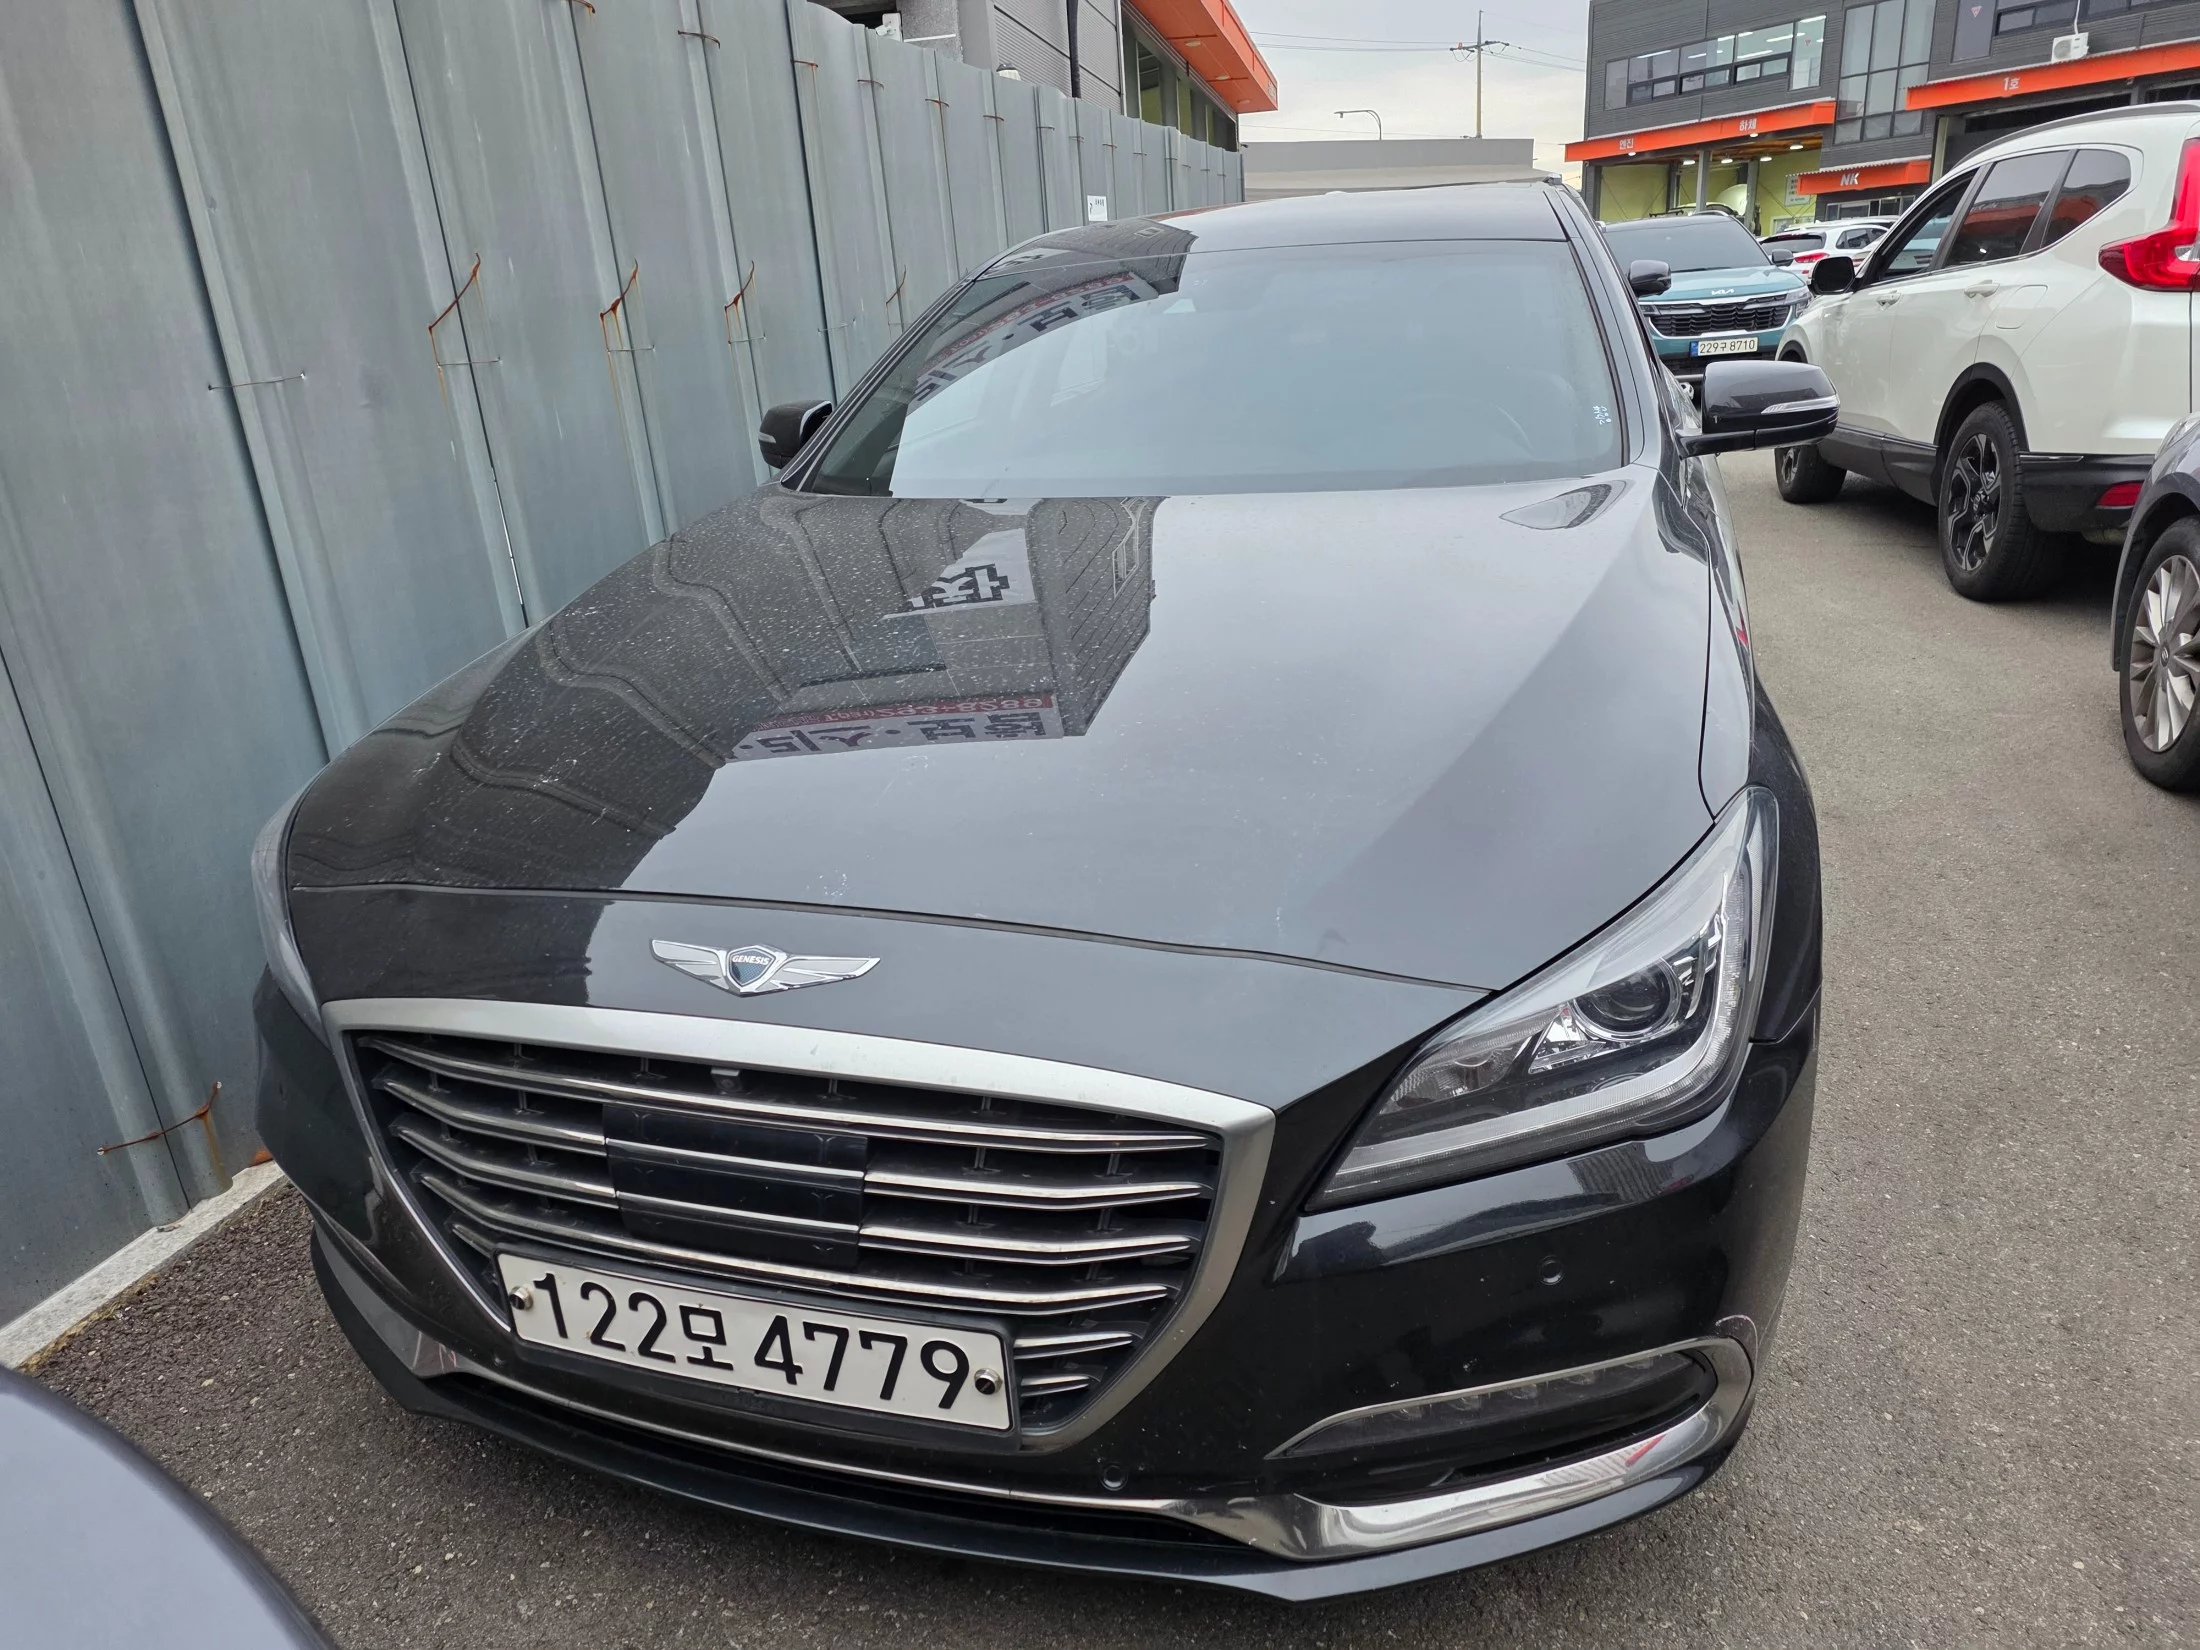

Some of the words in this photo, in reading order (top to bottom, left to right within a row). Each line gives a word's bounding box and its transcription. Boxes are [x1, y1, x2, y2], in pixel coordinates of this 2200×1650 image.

[2003, 76, 2020, 91] 1호
[1619, 138, 1634, 150] 엔진
[1840, 172, 1860, 186] NK
[1700, 341, 1727, 354] 229구
[1729, 339, 1755, 352] 8710
[731, 955, 770, 966] GENESIS
[532, 1272, 734, 1371] 122모
[753, 1315, 970, 1410] 4779
